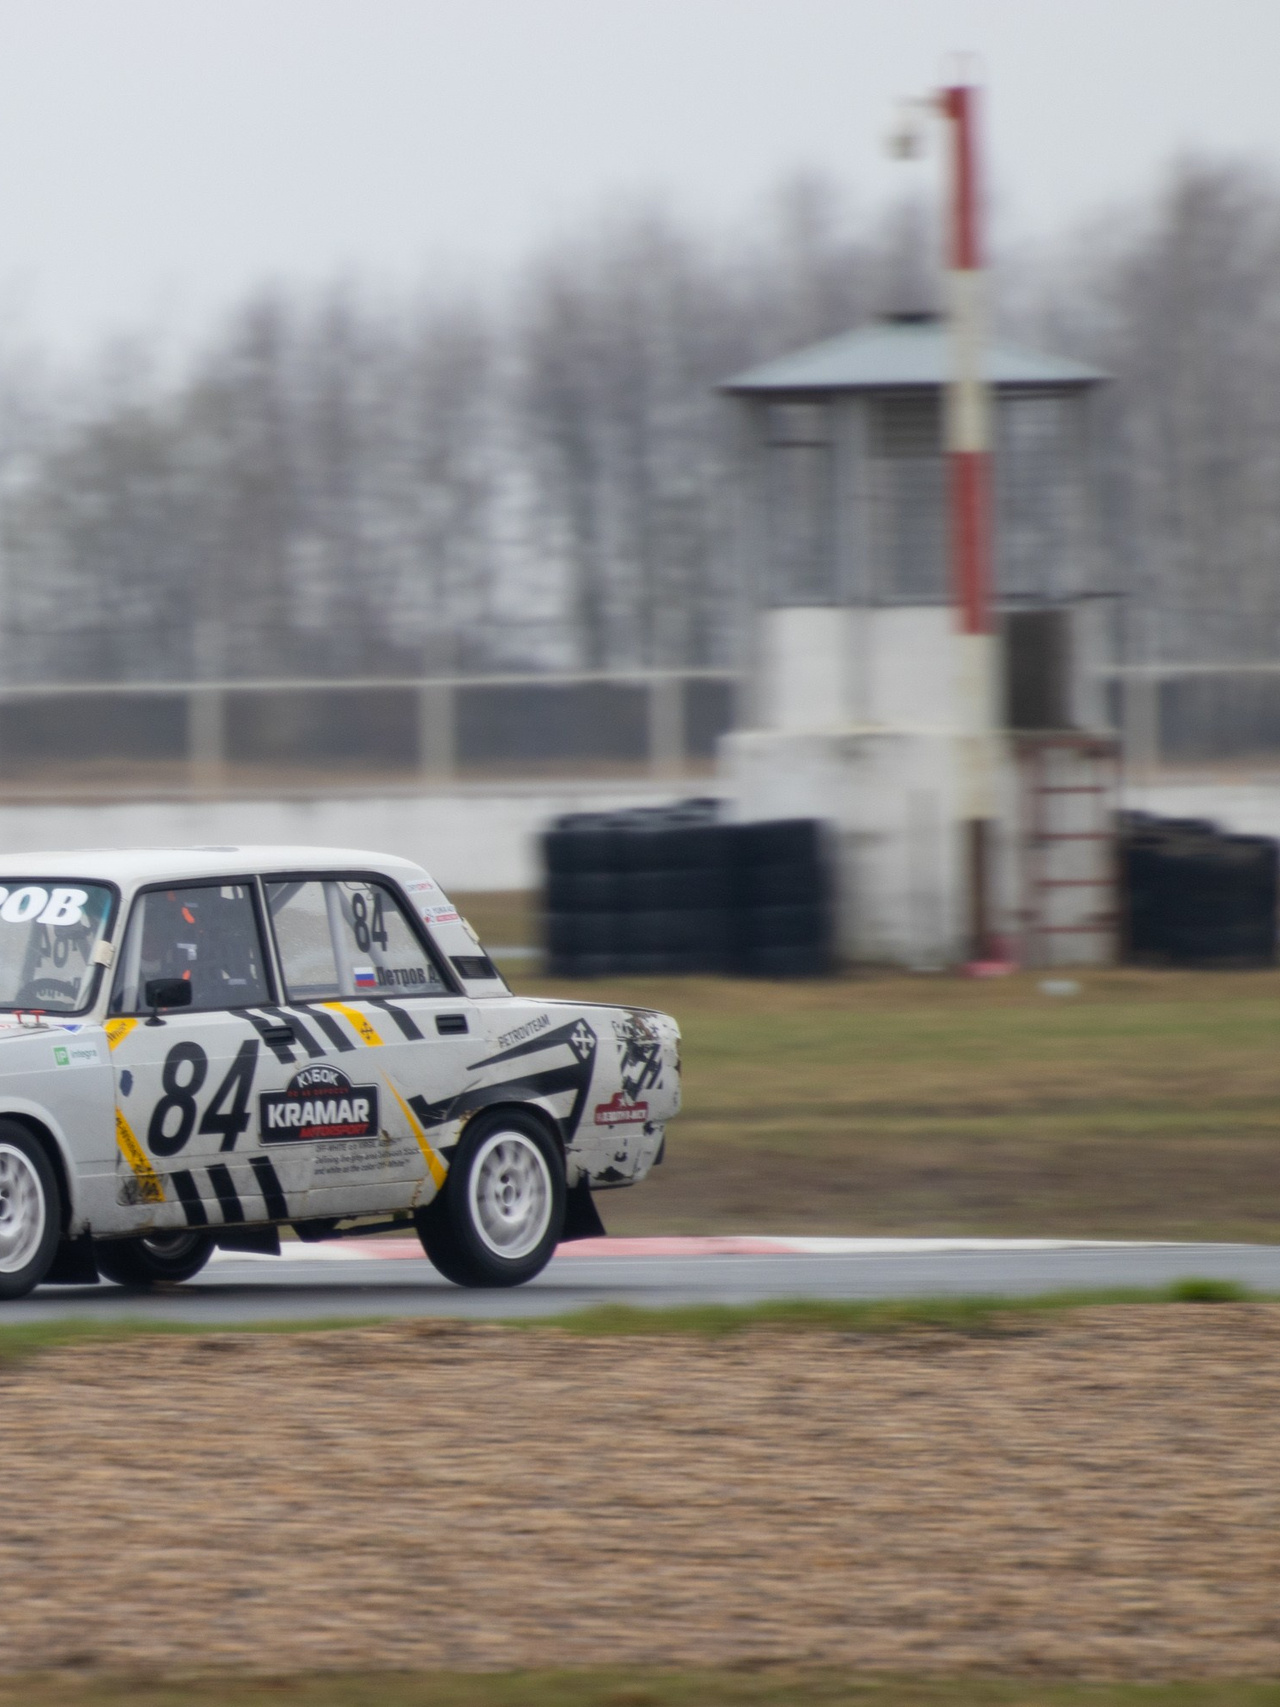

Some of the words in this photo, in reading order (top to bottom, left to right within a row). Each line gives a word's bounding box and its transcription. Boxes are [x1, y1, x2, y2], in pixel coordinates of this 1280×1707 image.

[352, 893, 388, 953] 84
[376, 966, 426, 987] Петров
[498, 1013, 551, 1048] PETROVTEAM
[147, 1039, 260, 1157] 84
[267, 1098, 370, 1128] KRAMAR
